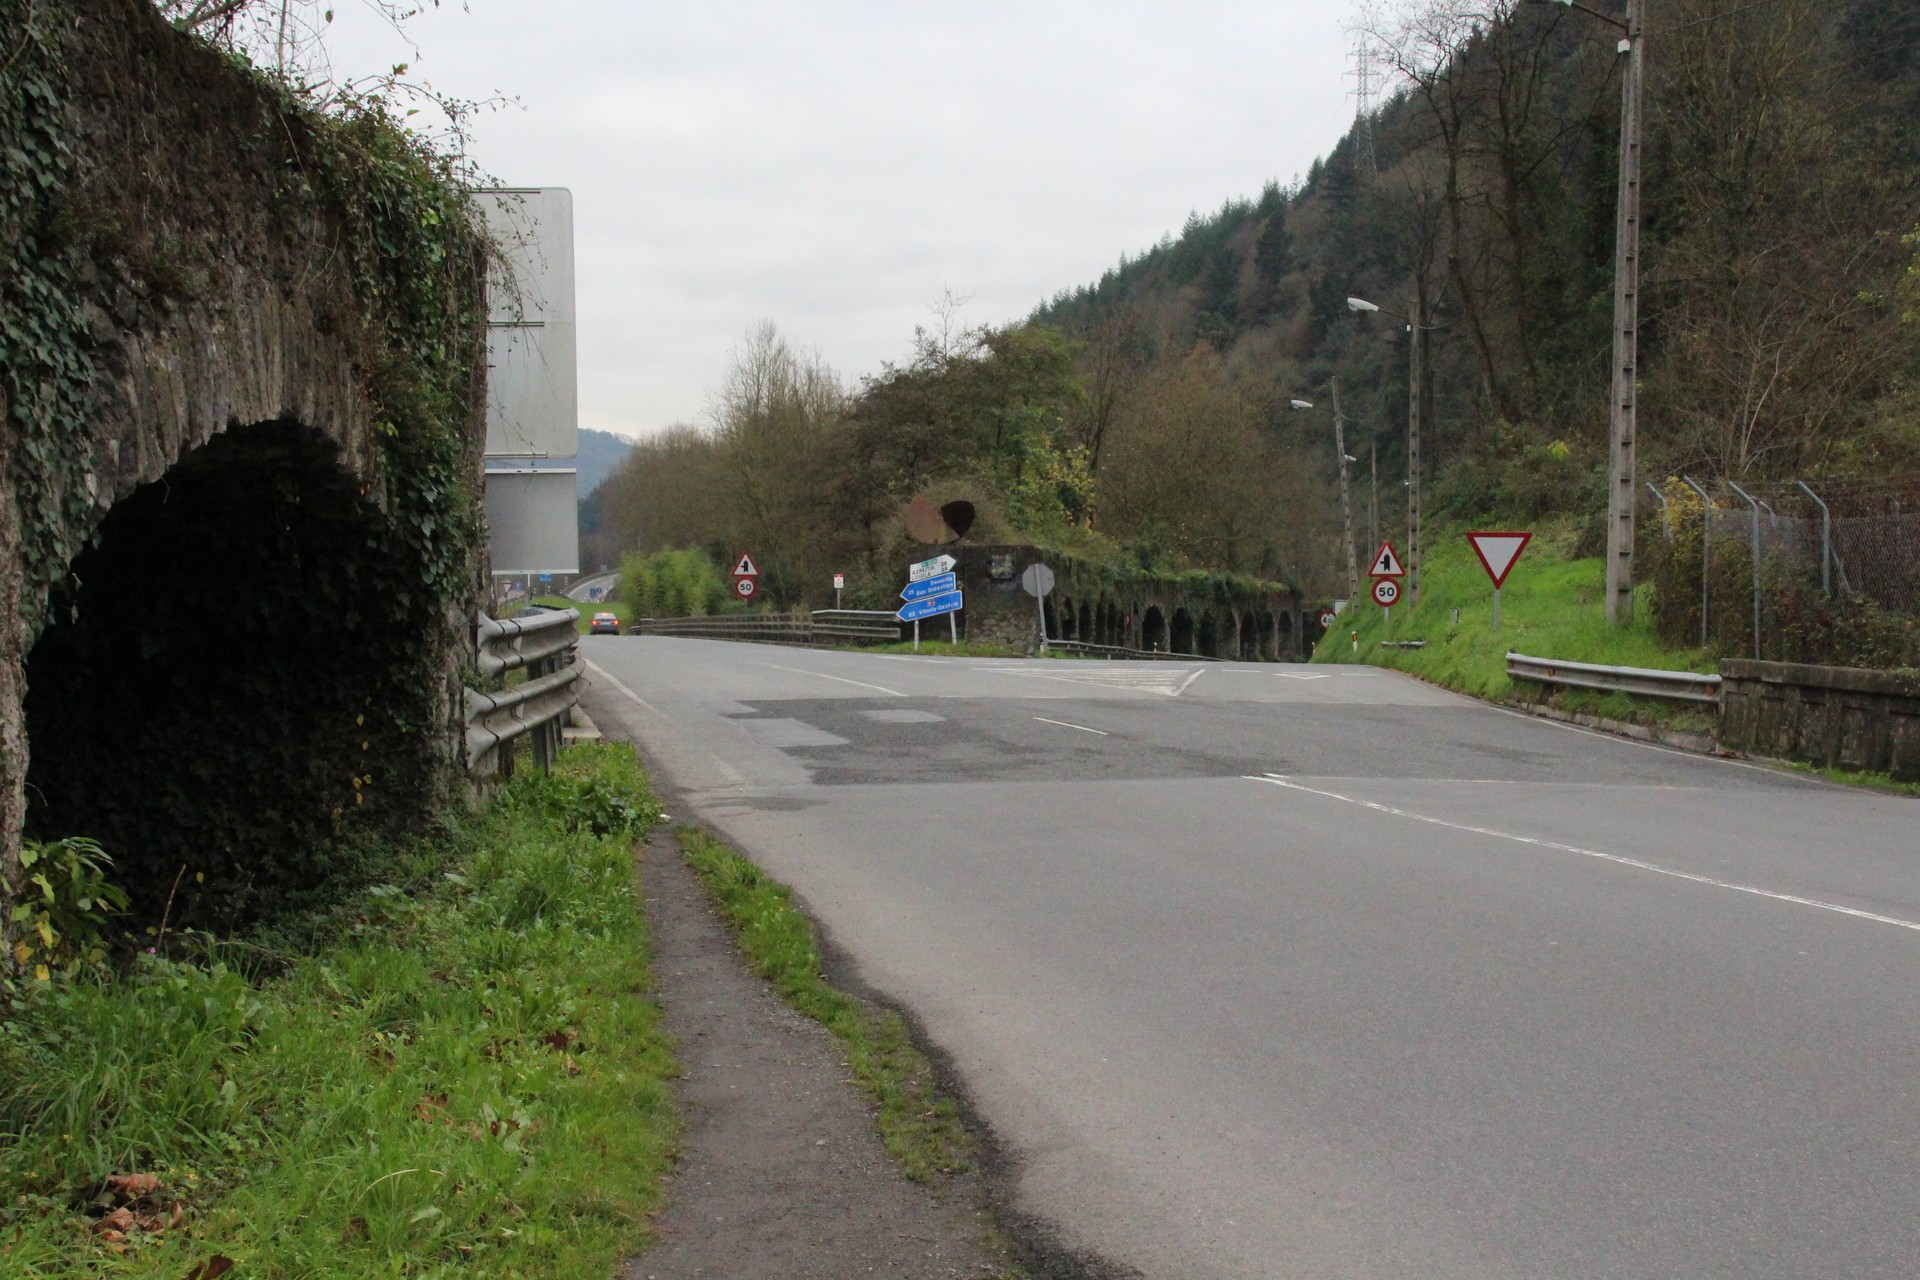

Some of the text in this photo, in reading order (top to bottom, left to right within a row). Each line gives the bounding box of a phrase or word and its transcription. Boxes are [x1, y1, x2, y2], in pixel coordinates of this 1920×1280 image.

[912, 565, 934, 575] AZPEITIA
[930, 576, 953, 585] Donostia
[1379, 587, 1394, 597] 50
[919, 602, 958, 615] Vitoria-Gasteiz
